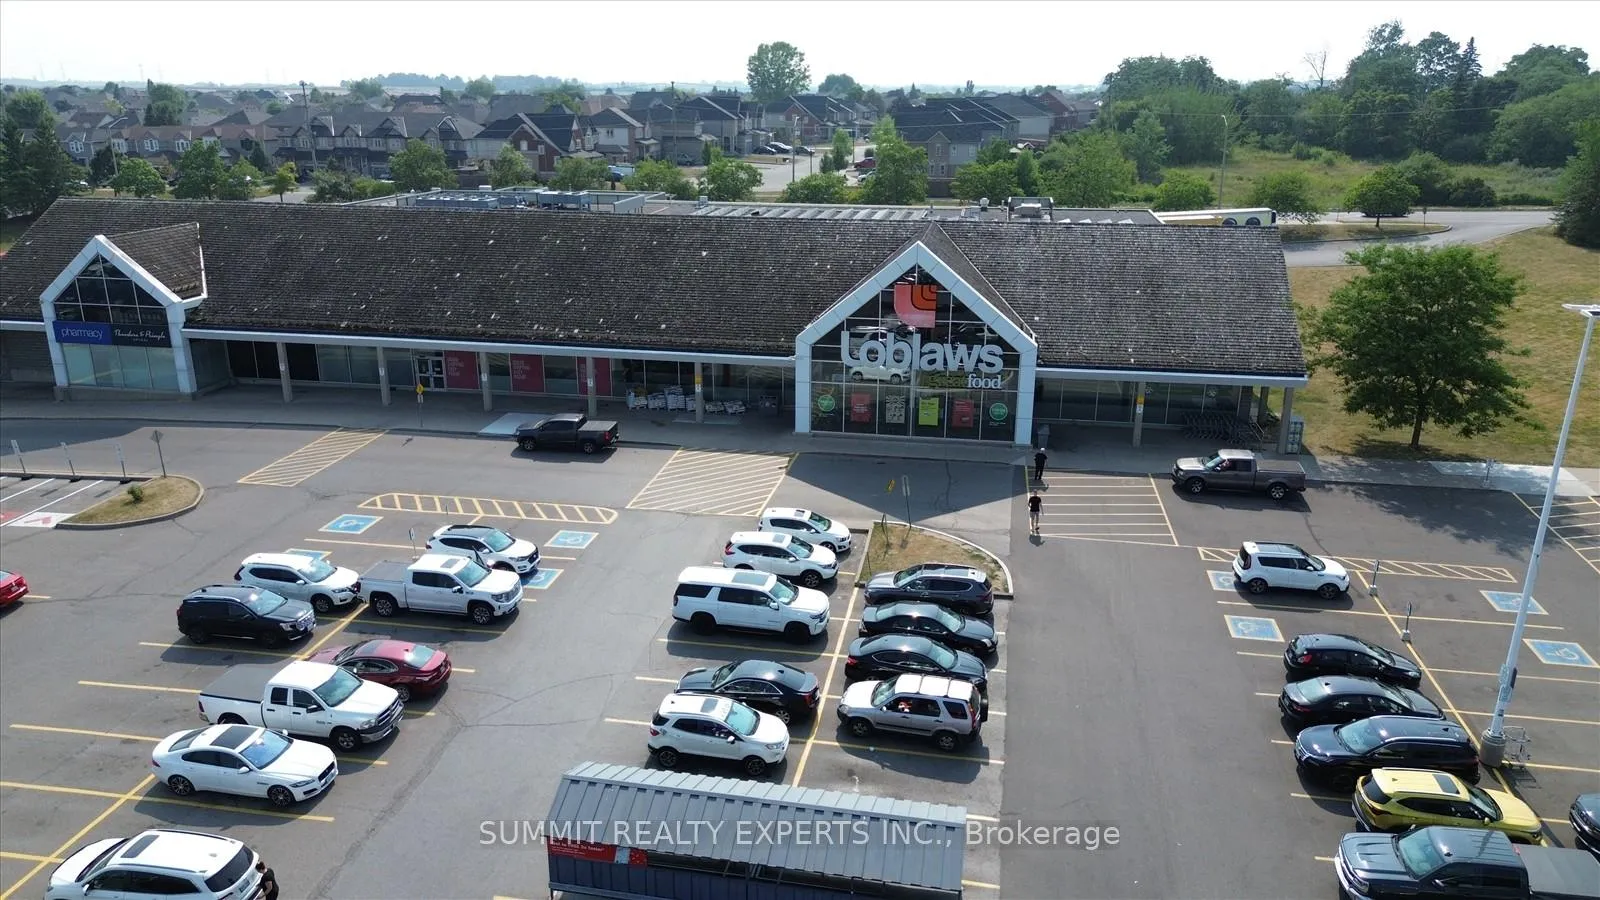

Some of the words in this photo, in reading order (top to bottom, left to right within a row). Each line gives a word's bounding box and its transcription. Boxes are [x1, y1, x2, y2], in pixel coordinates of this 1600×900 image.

[61, 327, 103, 339] pharmacy
[841, 330, 1004, 374] Loblaws
[967, 373, 1001, 389] food
